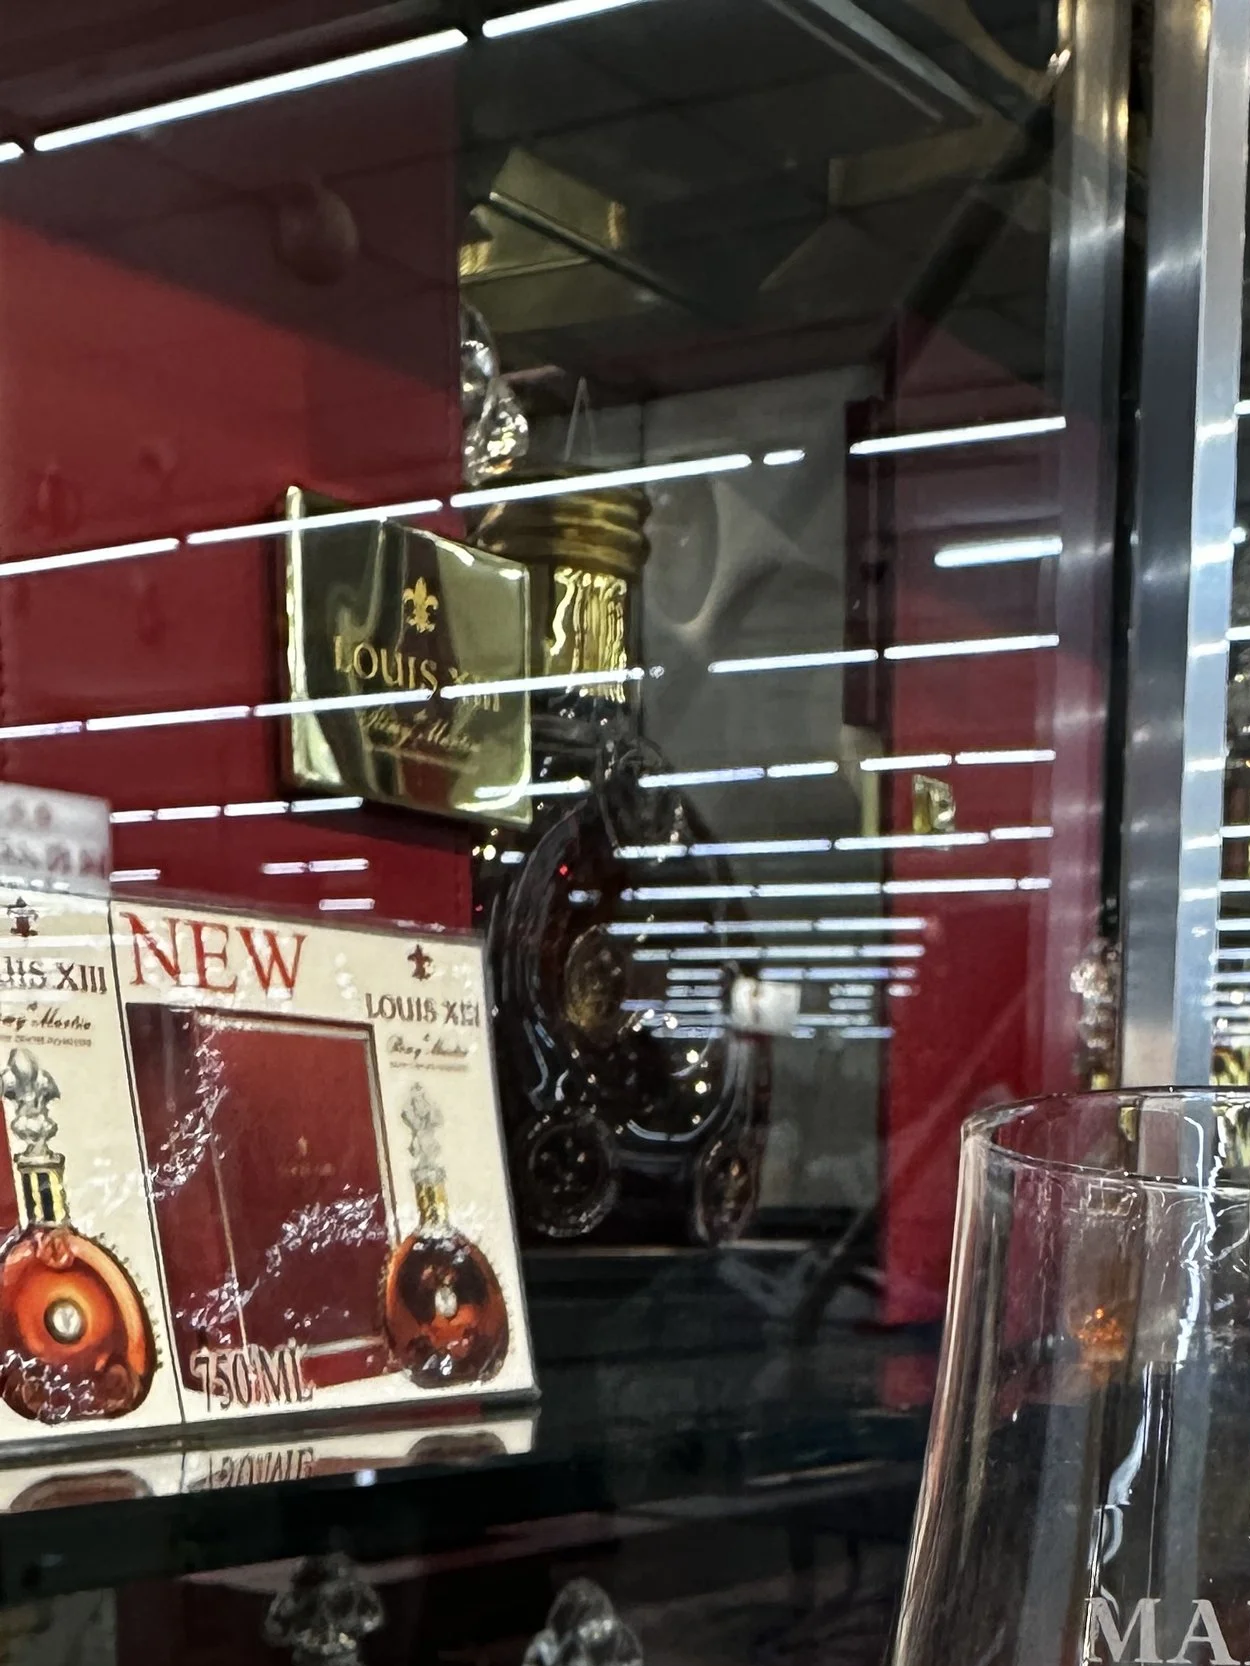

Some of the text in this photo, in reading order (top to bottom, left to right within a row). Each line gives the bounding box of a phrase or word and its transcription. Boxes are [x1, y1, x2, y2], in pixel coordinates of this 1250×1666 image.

[119, 911, 308, 999] NEW
[56, 961, 107, 994] XIII
[365, 993, 437, 1022] LOUIS
